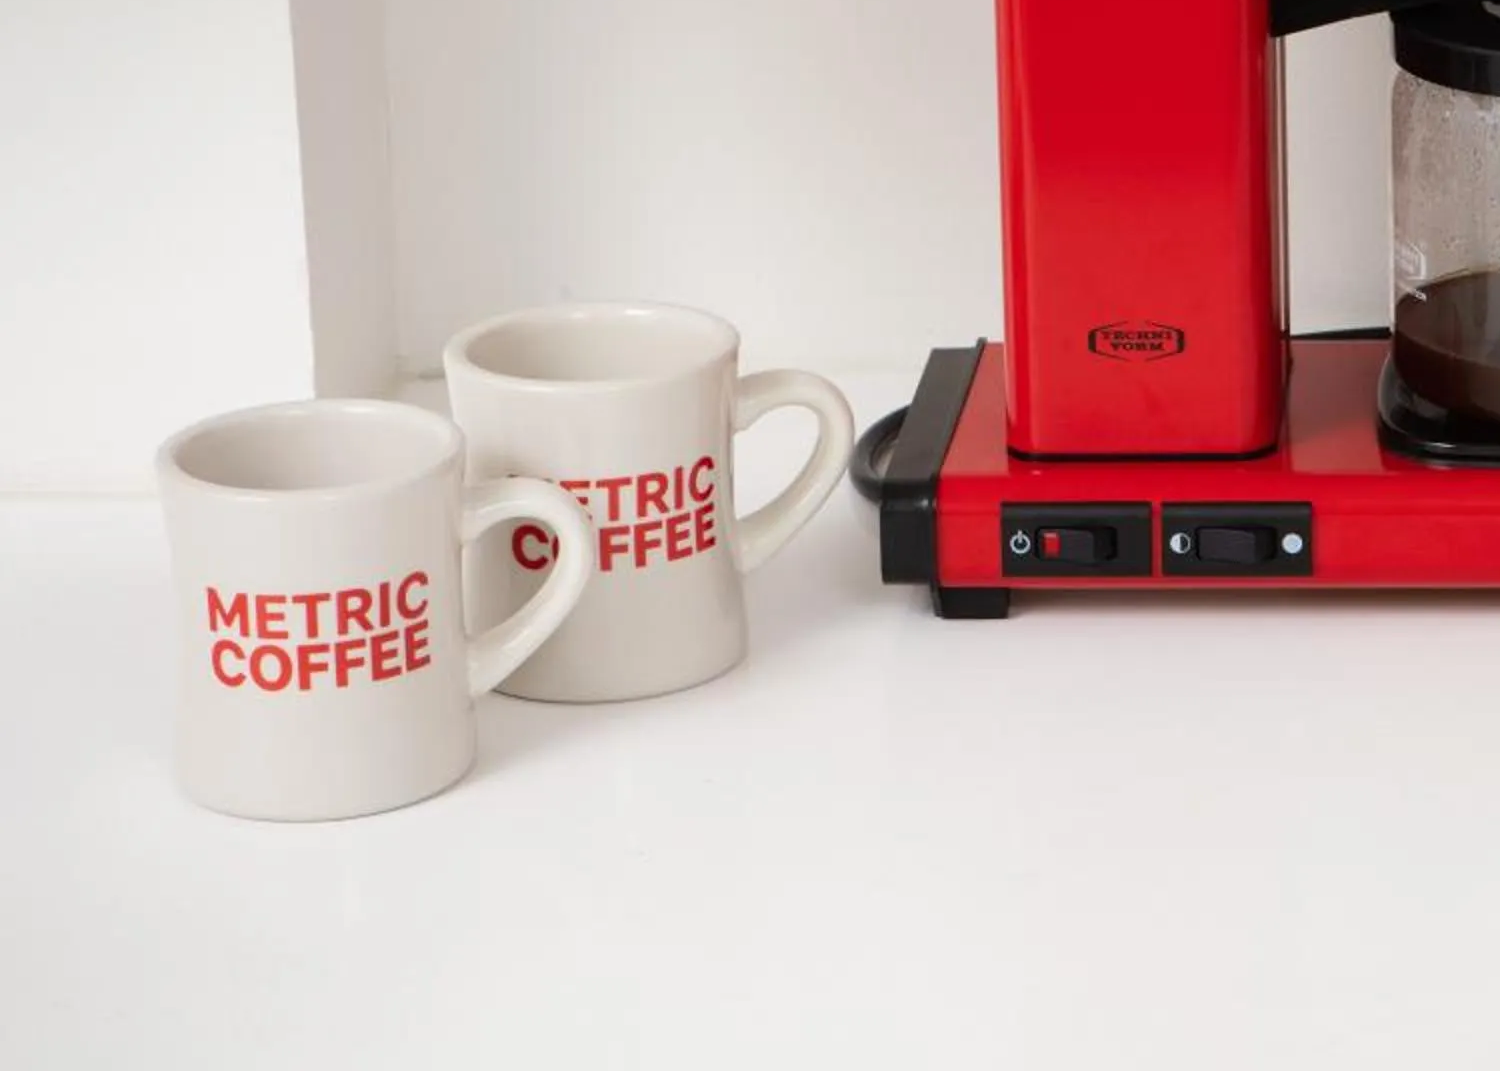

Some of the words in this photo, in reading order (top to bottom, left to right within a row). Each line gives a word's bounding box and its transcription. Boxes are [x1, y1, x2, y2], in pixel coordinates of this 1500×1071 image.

[559, 455, 715, 522] TRIC
[511, 501, 717, 572] CFFEE
[206, 570, 429, 639] METRIC
[211, 619, 431, 692] COFFEE
